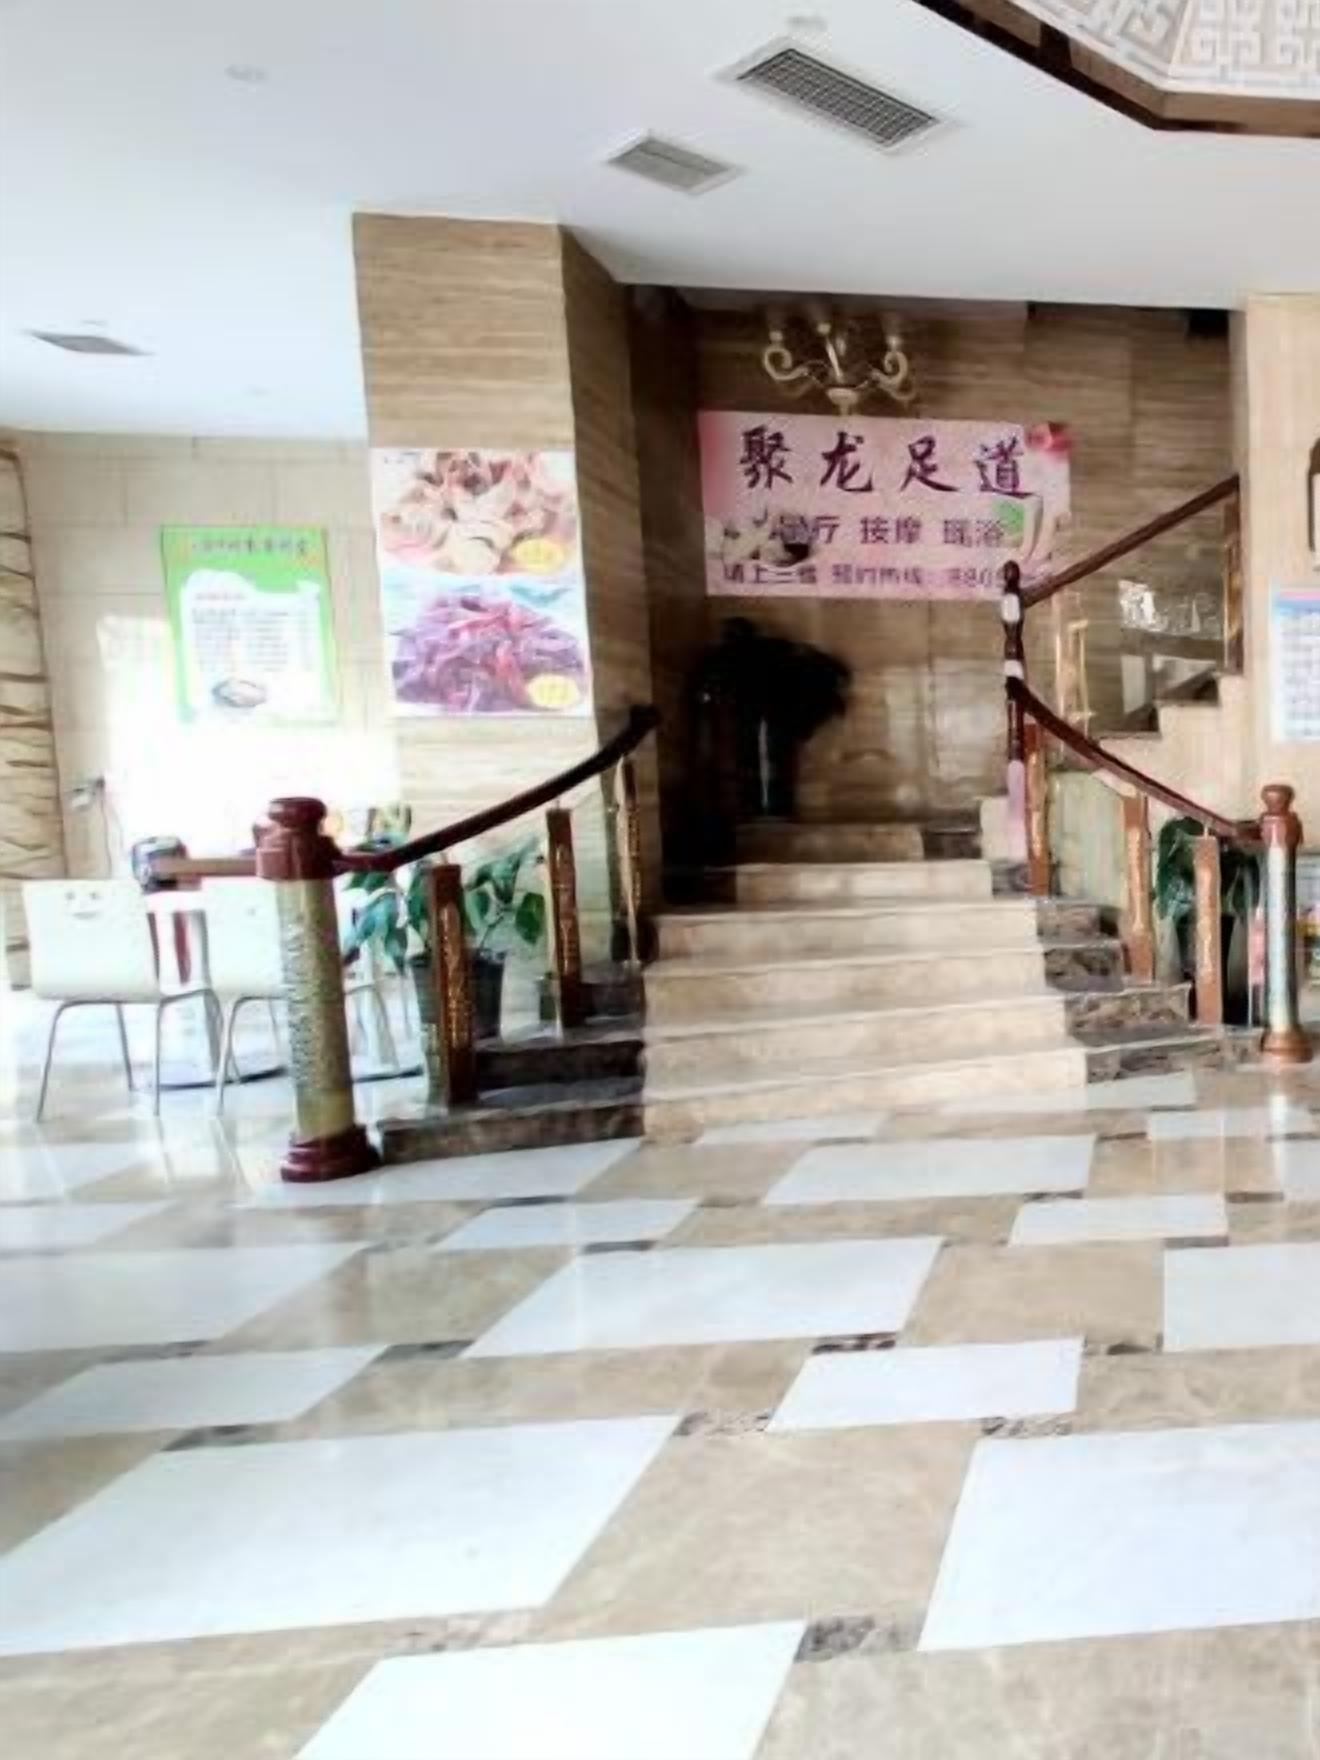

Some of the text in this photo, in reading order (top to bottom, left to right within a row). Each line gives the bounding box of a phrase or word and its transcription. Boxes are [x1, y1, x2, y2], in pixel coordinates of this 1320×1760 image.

[740, 424, 1036, 497] 聚龙足道
[860, 516, 922, 545] 按摩
